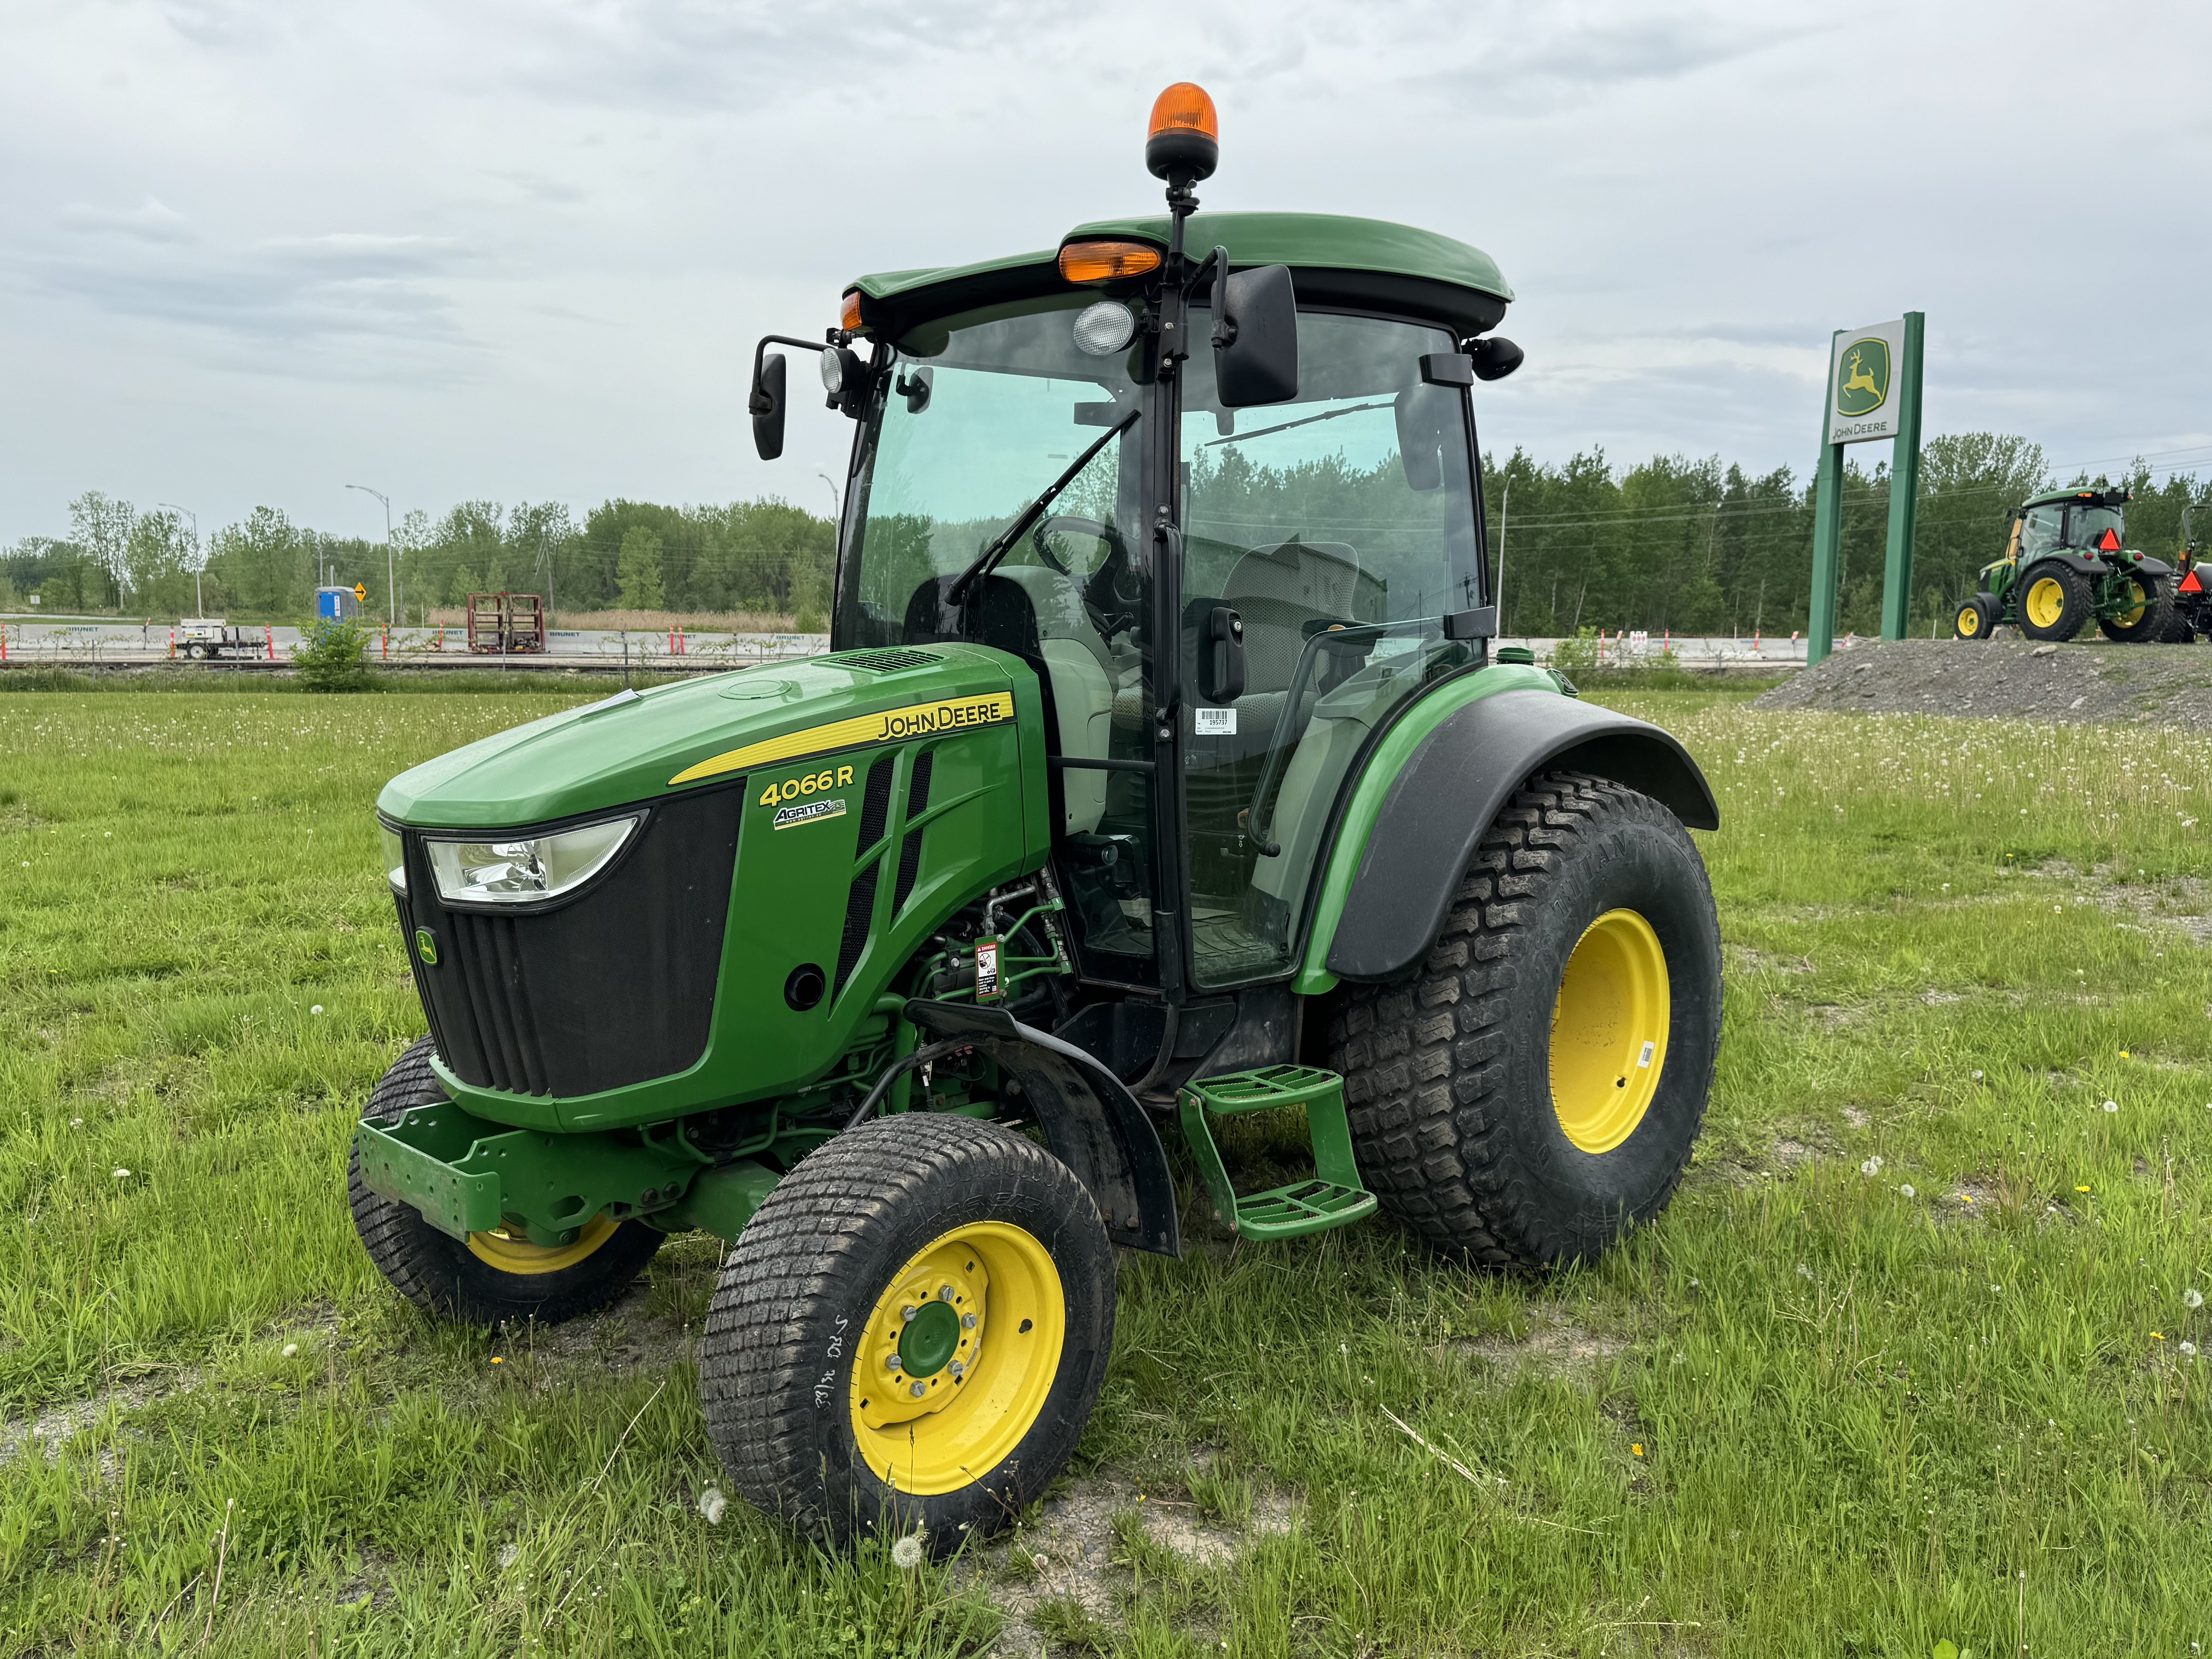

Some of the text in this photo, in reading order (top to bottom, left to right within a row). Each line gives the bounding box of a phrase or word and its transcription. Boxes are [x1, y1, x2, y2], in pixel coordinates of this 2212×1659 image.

[1833, 421, 1887, 439] JOHN DEERE
[878, 702, 1001, 738] JOHN DEERE
[775, 801, 831, 822] AGRITEX
